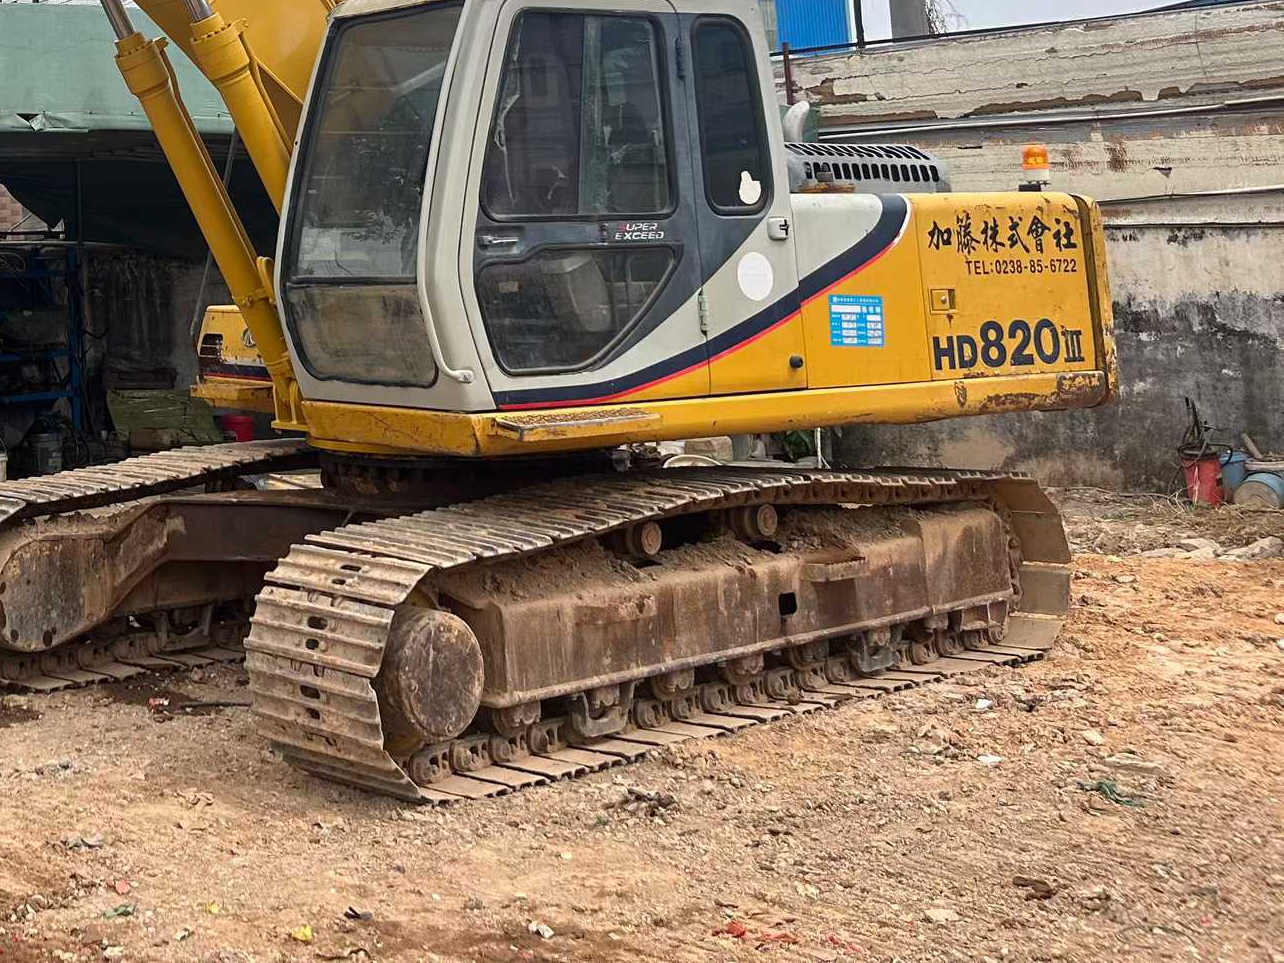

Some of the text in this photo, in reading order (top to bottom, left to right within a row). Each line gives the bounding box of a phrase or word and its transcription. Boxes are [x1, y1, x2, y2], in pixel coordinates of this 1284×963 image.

[619, 223, 658, 232] SUPER
[928, 210, 1077, 255] 加藤株式會社
[615, 231, 665, 240] EXCEED
[966, 259, 1077, 275] TEL:0238-85-6722
